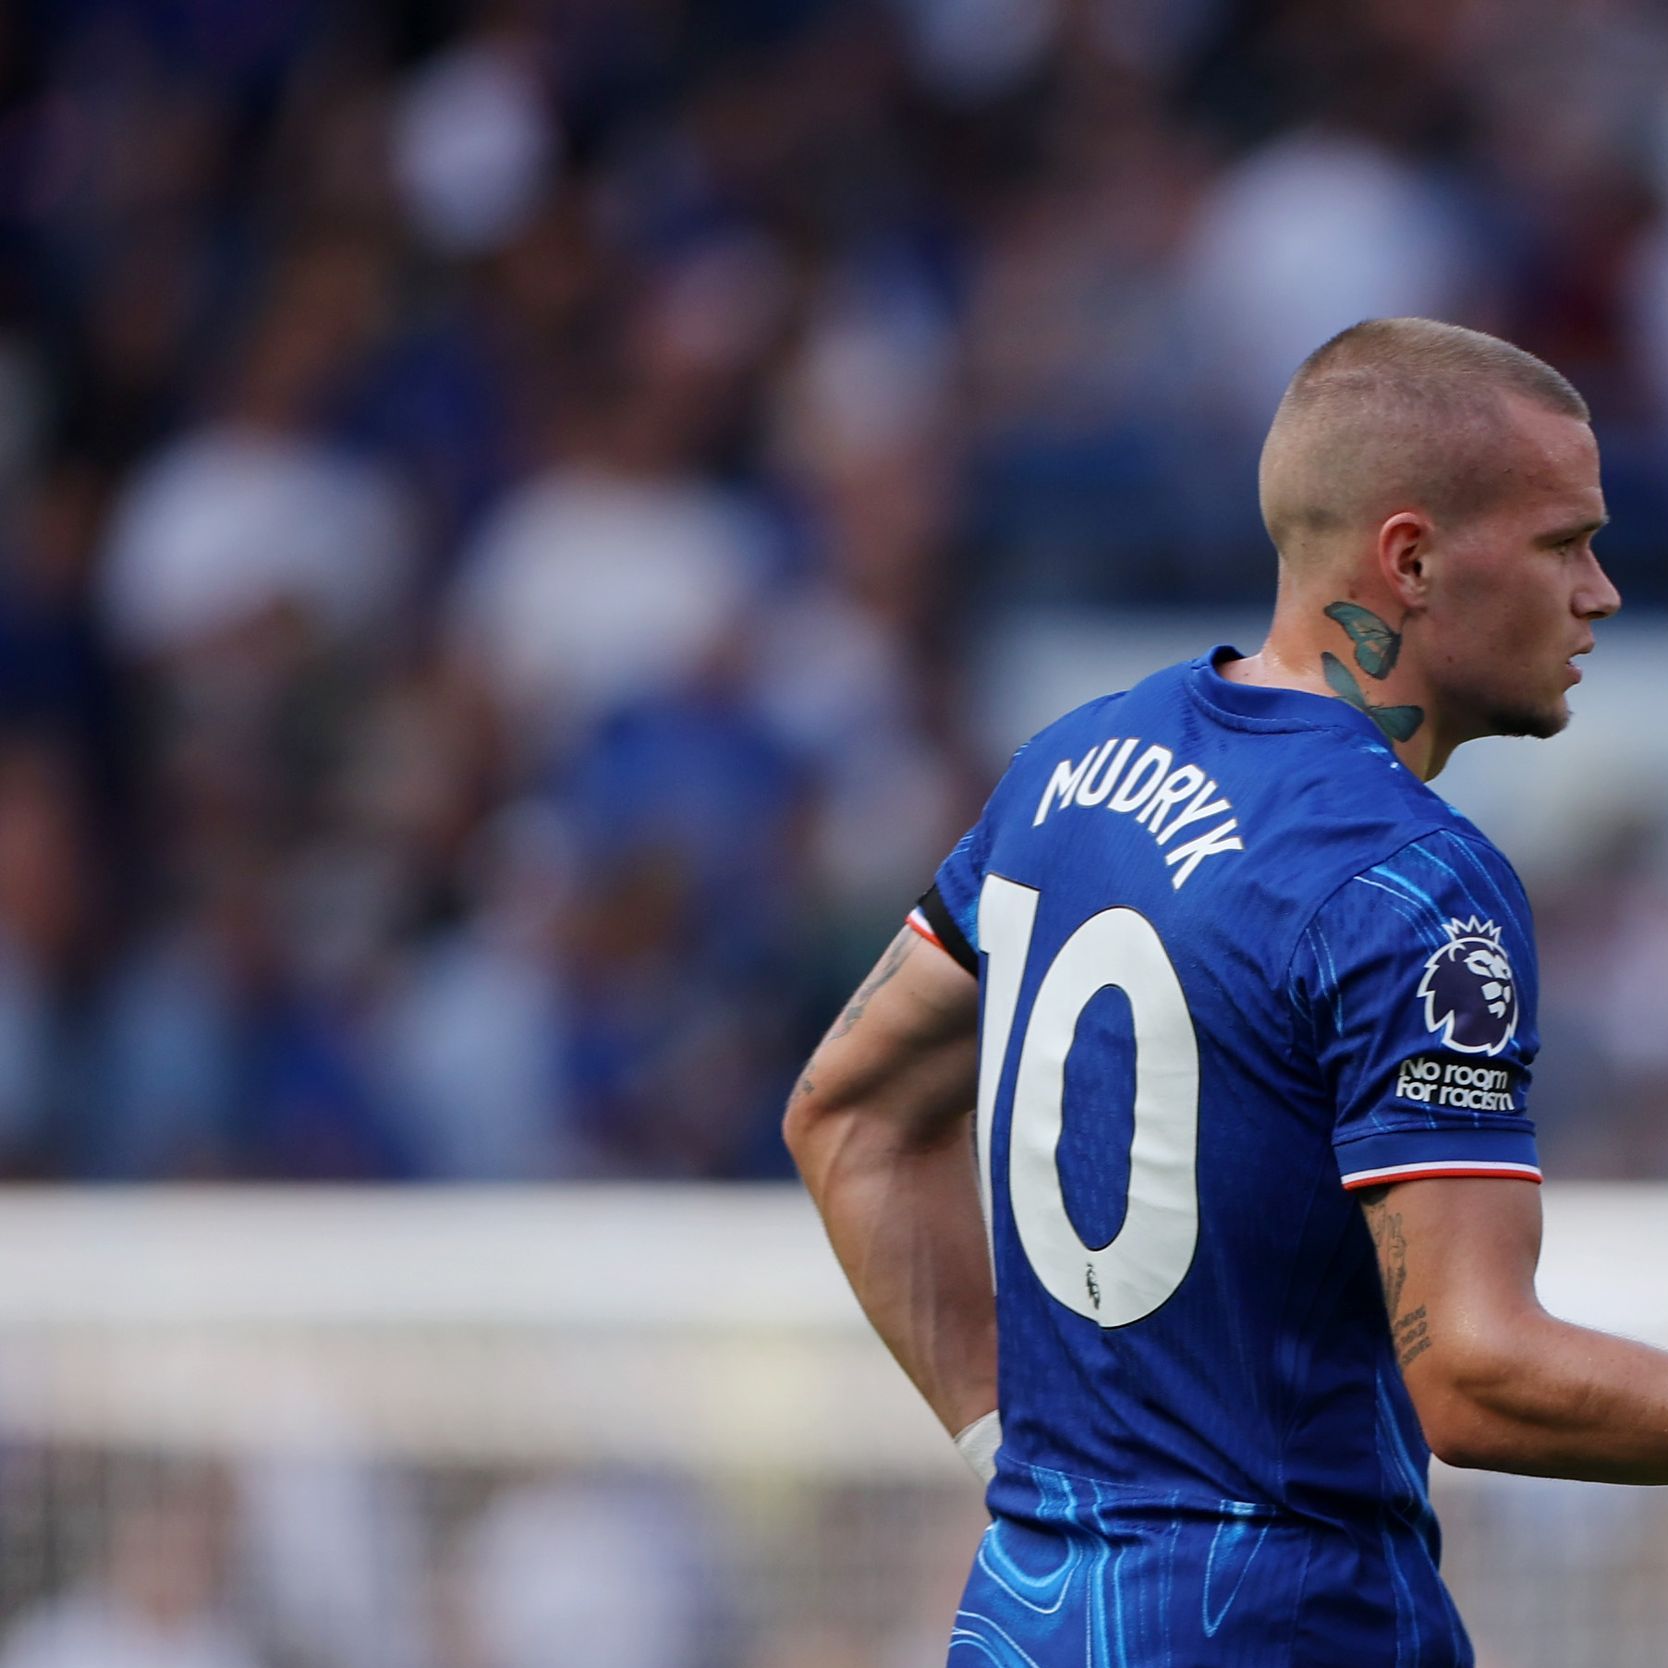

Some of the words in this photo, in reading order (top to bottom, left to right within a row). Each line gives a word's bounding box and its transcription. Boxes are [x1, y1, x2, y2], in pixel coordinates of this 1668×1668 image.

[1033, 738, 1244, 890] MUDRYK
[976, 872, 1199, 1328] 10
[1396, 1076, 1437, 1102] for
[1439, 1085, 1516, 1111] racism
[1400, 1058, 1440, 1080] No
[1444, 1064, 1508, 1089] room
